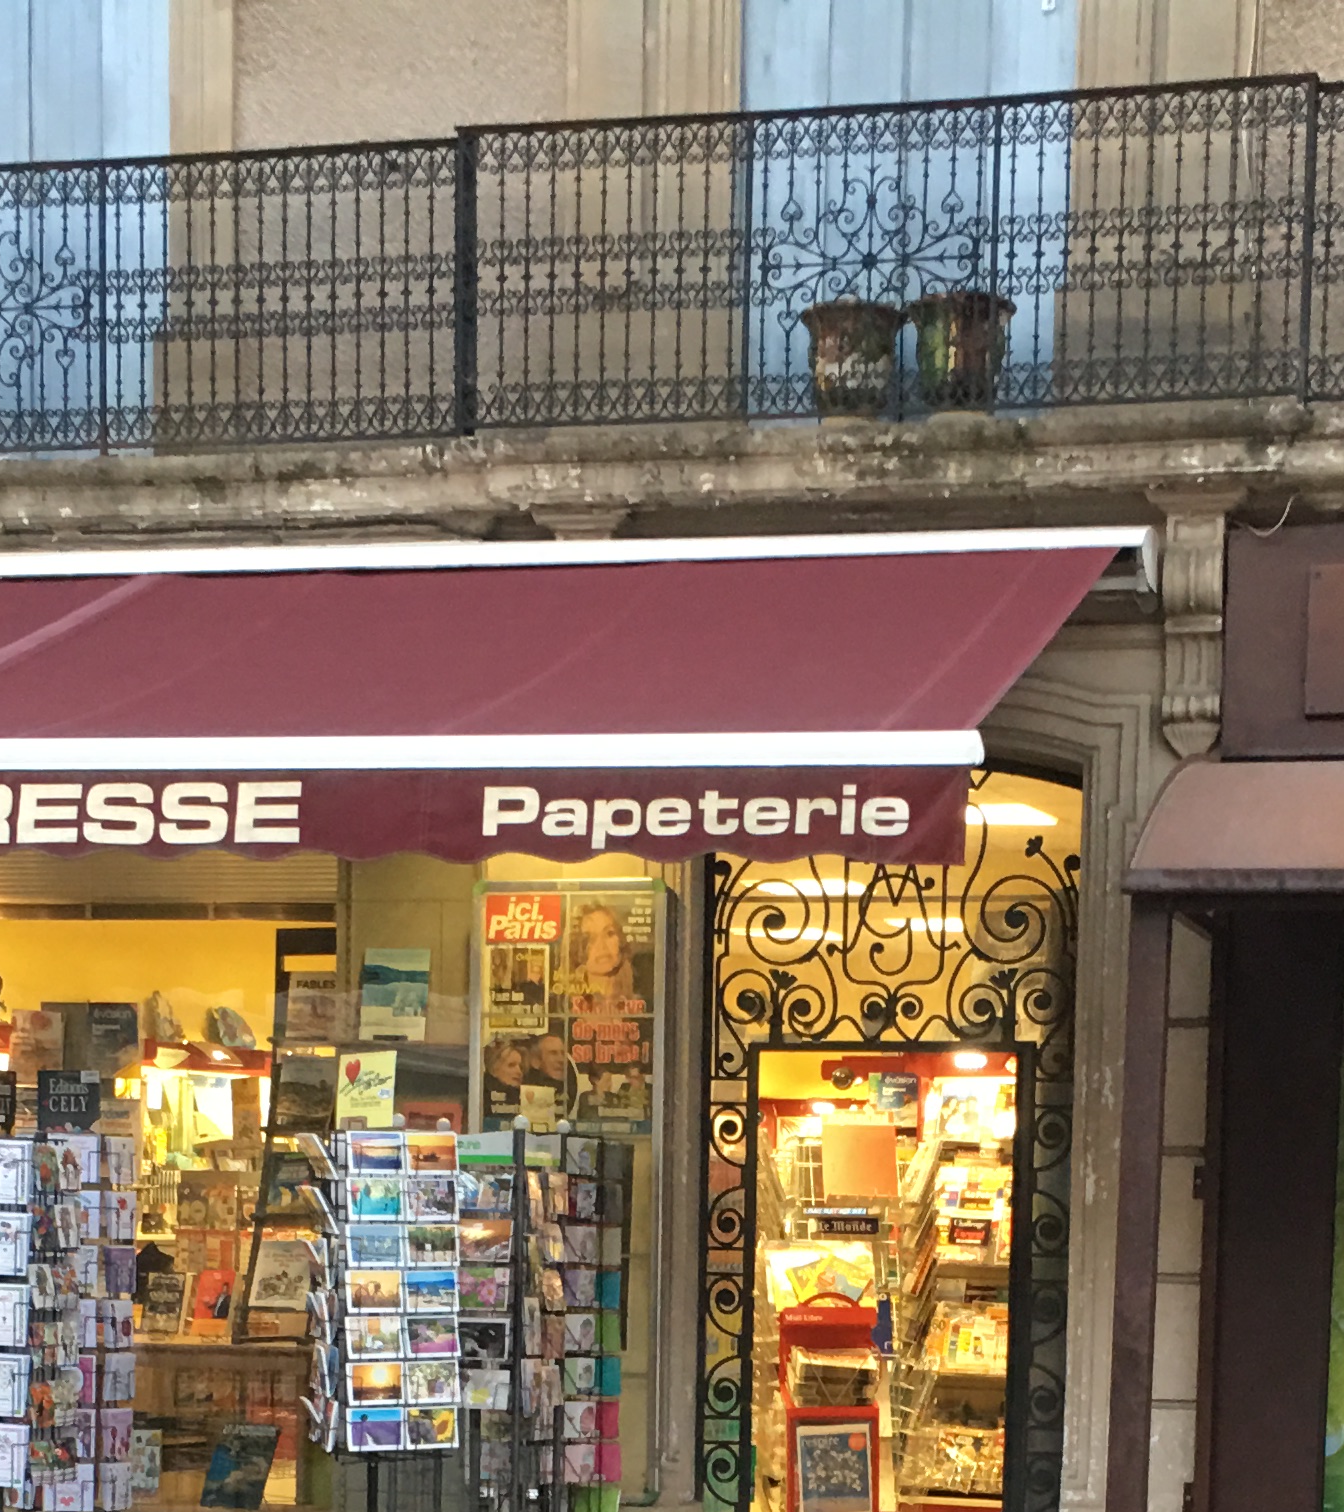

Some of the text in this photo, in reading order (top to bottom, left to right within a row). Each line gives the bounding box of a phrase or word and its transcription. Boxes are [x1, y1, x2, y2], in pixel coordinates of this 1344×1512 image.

[482, 784, 909, 850] Papeterie
[488, 914, 558, 940] Paris
[296, 979, 336, 990] FABLES
[49, 1096, 90, 1112] CELY
[831, 1219, 873, 1232] Monde
